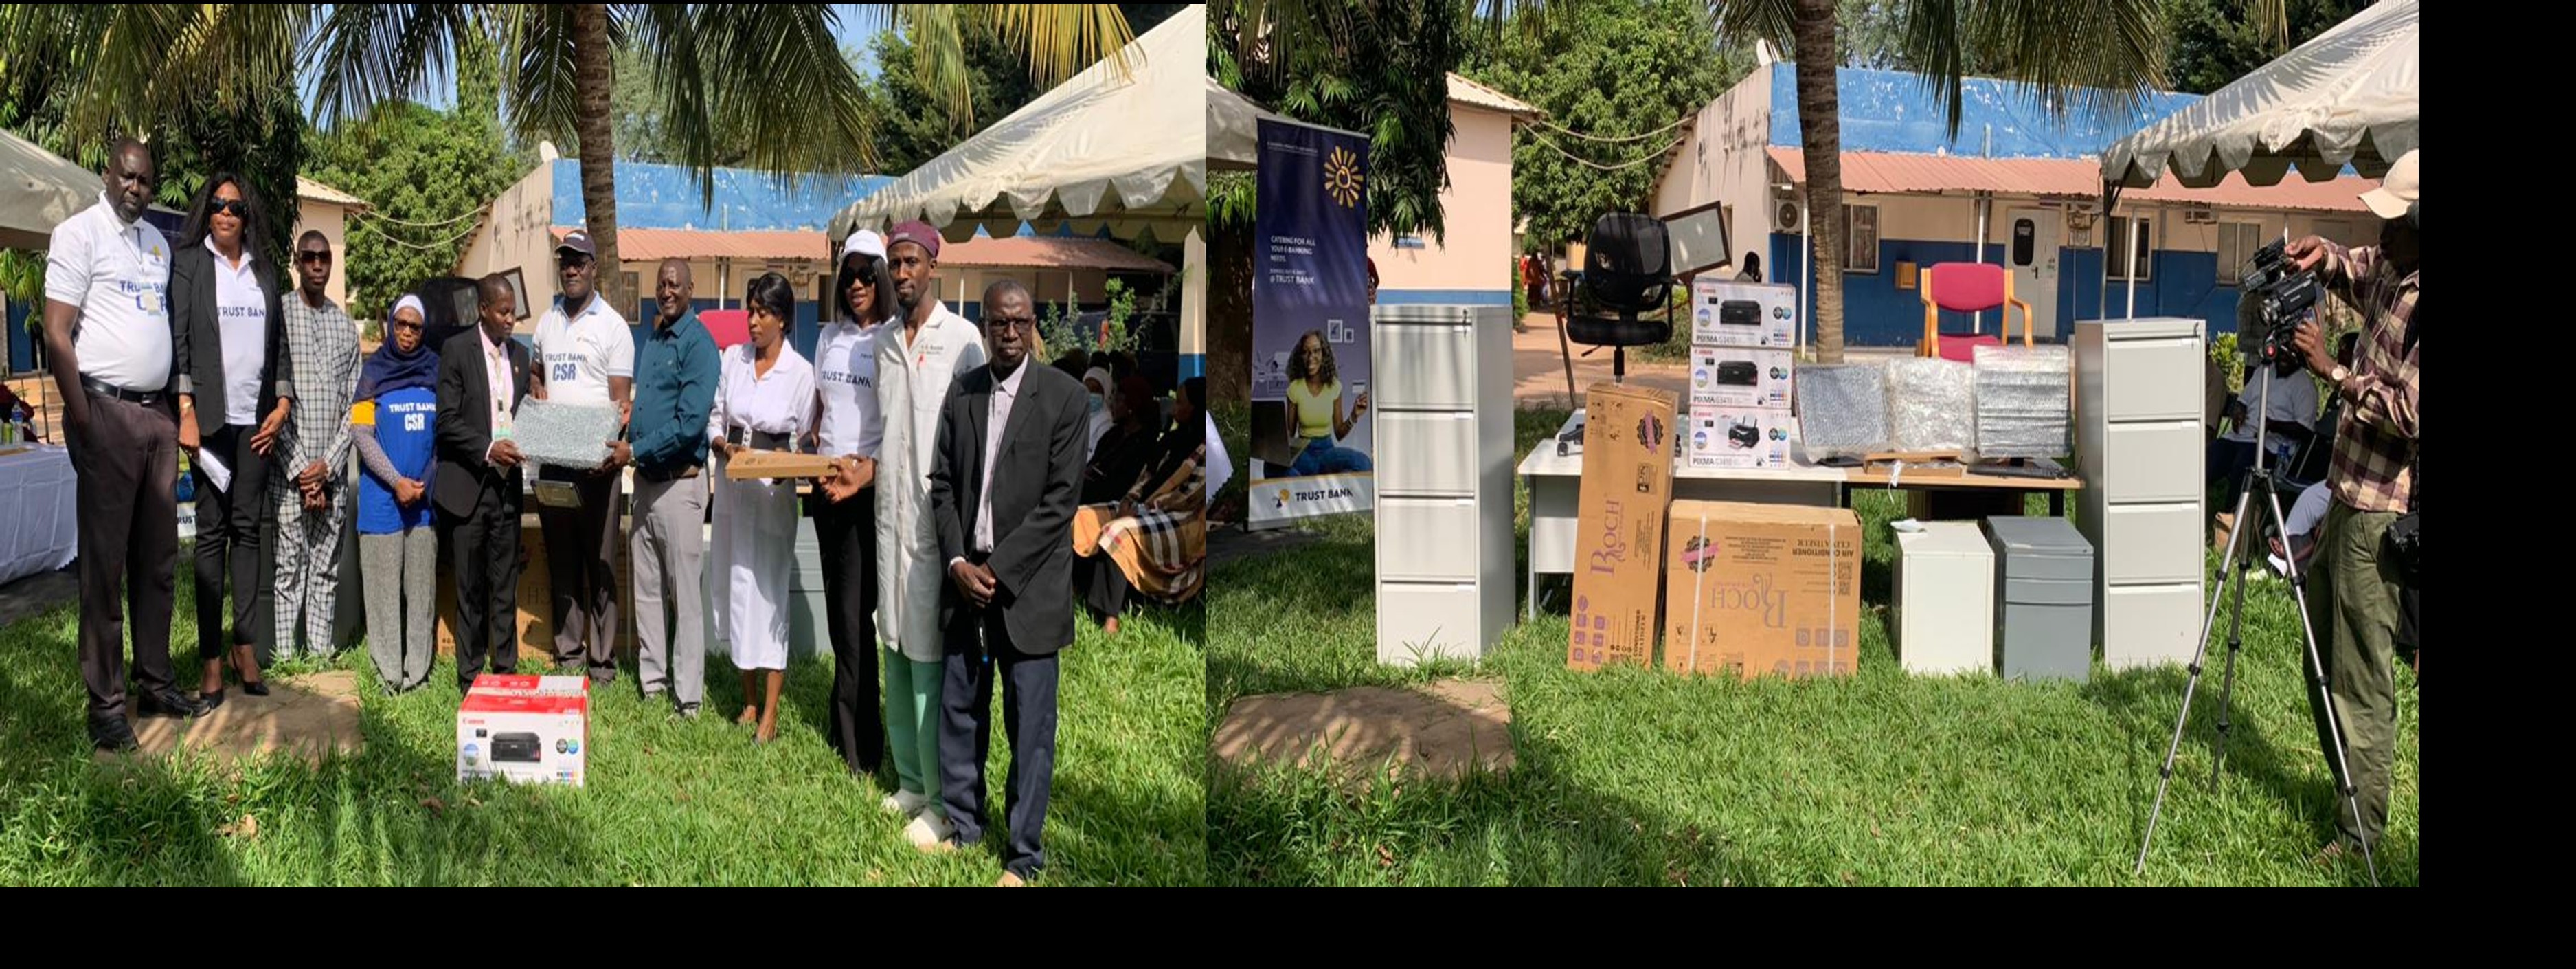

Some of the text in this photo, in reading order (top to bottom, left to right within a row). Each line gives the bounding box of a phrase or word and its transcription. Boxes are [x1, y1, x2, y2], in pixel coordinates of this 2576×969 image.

[1276, 275, 1295, 283] TRUST
[247, 307, 265, 318] BAN
[1697, 334, 1717, 342] PIXMA
[545, 353, 567, 362] TRUST
[553, 364, 576, 381] CSR
[846, 374, 871, 388] BANK
[389, 403, 414, 412] TRUST
[404, 413, 425, 432] CSR
[1693, 457, 1714, 465] PIXMA
[1295, 487, 1353, 502] TRUST BANK
[1792, 548, 1854, 557] AIR CNDITIONER
[1710, 572, 1789, 629] ROCH
